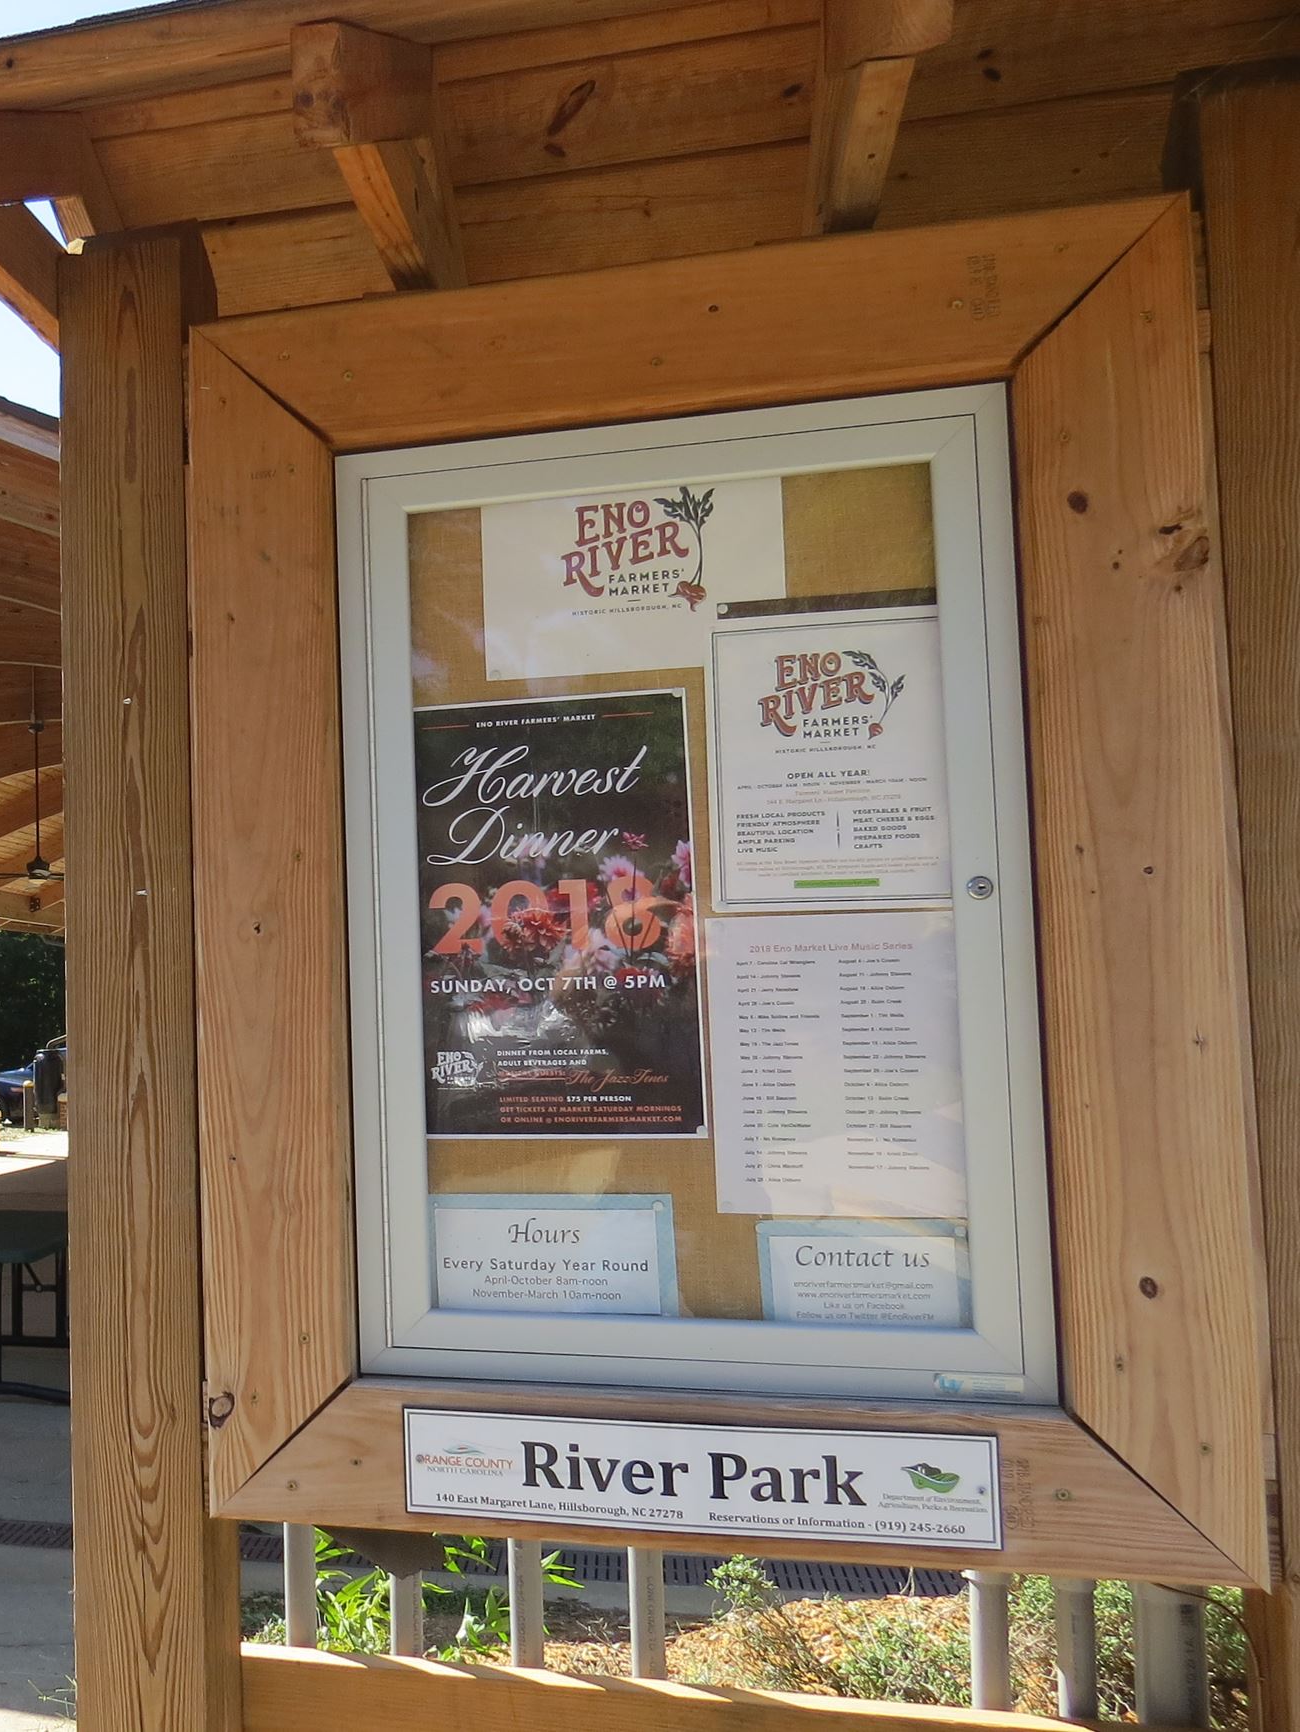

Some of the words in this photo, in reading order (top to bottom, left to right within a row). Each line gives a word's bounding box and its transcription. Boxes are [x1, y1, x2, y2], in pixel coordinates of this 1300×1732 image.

[575, 501, 650, 547] ENO
[561, 521, 689, 597] RIVER
[609, 568, 685, 583] FARMERS'
[609, 583, 669, 596] MARKET
[572, 608, 606, 616] HISTORIC
[775, 651, 842, 692] ENO
[758, 671, 875, 737] RIVER
[521, 717, 560, 725] FARMERS'
[563, 714, 596, 722] MARKET
[803, 715, 873, 727] FARMERS'
[803, 727, 859, 738] MARKET
[423, 745, 647, 806] Harvest
[787, 772, 813, 780] OPEN
[818, 770, 836, 778] ALL
[840, 769, 870, 777] YEAR!
[427, 805, 619, 865] Dinner
[429, 875, 662, 955] 2018
[750, 945, 771, 953] 2018
[774, 945, 791, 953] Eno
[795, 944, 826, 952] Market
[883, 942, 913, 950] Series
[431, 977, 513, 994] SUNDAY,
[519, 977, 556, 991] OCT
[562, 976, 597, 990] 7TH
[603, 976, 618, 990] @
[624, 974, 666, 988] 5PM
[437, 1051, 461, 1066] ENO
[431, 1060, 475, 1084] RIVER
[566, 1070, 593, 1084] The
[591, 1069, 628, 1092] Jazz
[567, 1095, 581, 1103] $75
[508, 1218, 580, 1244] Hours
[796, 1245, 894, 1267] Contact
[903, 1251, 930, 1268] us
[443, 1257, 483, 1271] Every
[490, 1257, 555, 1272] Saturday
[563, 1259, 595, 1271] Year
[602, 1260, 649, 1272] Round
[484, 1275, 552, 1286] April-October
[556, 1276, 608, 1286] 8am-noon
[794, 1281, 934, 1290] enoriverfarmersmarket@gmail.com
[473, 1288, 558, 1300] November-March
[563, 1290, 621, 1300] 10am-noon
[797, 1291, 931, 1300] www.enoriverfarmersmarket.com
[867, 1302, 905, 1310] Facebook
[796, 1311, 822, 1319] Follow
[849, 1312, 878, 1320] Twitter
[415, 1453, 462, 1467] ORANGE
[466, 1456, 513, 1470] COUNTY
[427, 1466, 458, 1474] NORTH
[460, 1467, 503, 1477] CAROLINA
[521, 1441, 688, 1497] River
[707, 1452, 867, 1507] Park
[883, 1493, 924, 1501] Department
[436, 1493, 455, 1502] 140
[457, 1494, 478, 1505] East
[480, 1496, 526, 1509] Margaret
[529, 1499, 556, 1512] Lane,
[558, 1501, 629, 1518] Hillsborough,
[632, 1507, 646, 1517] NC
[650, 1508, 684, 1519] 27278
[709, 1512, 779, 1524] Reservations
[782, 1516, 793, 1525] or
[798, 1516, 865, 1529] Information
[874, 1520, 906, 1533] (919)
[909, 1521, 965, 1534] 245-2660
